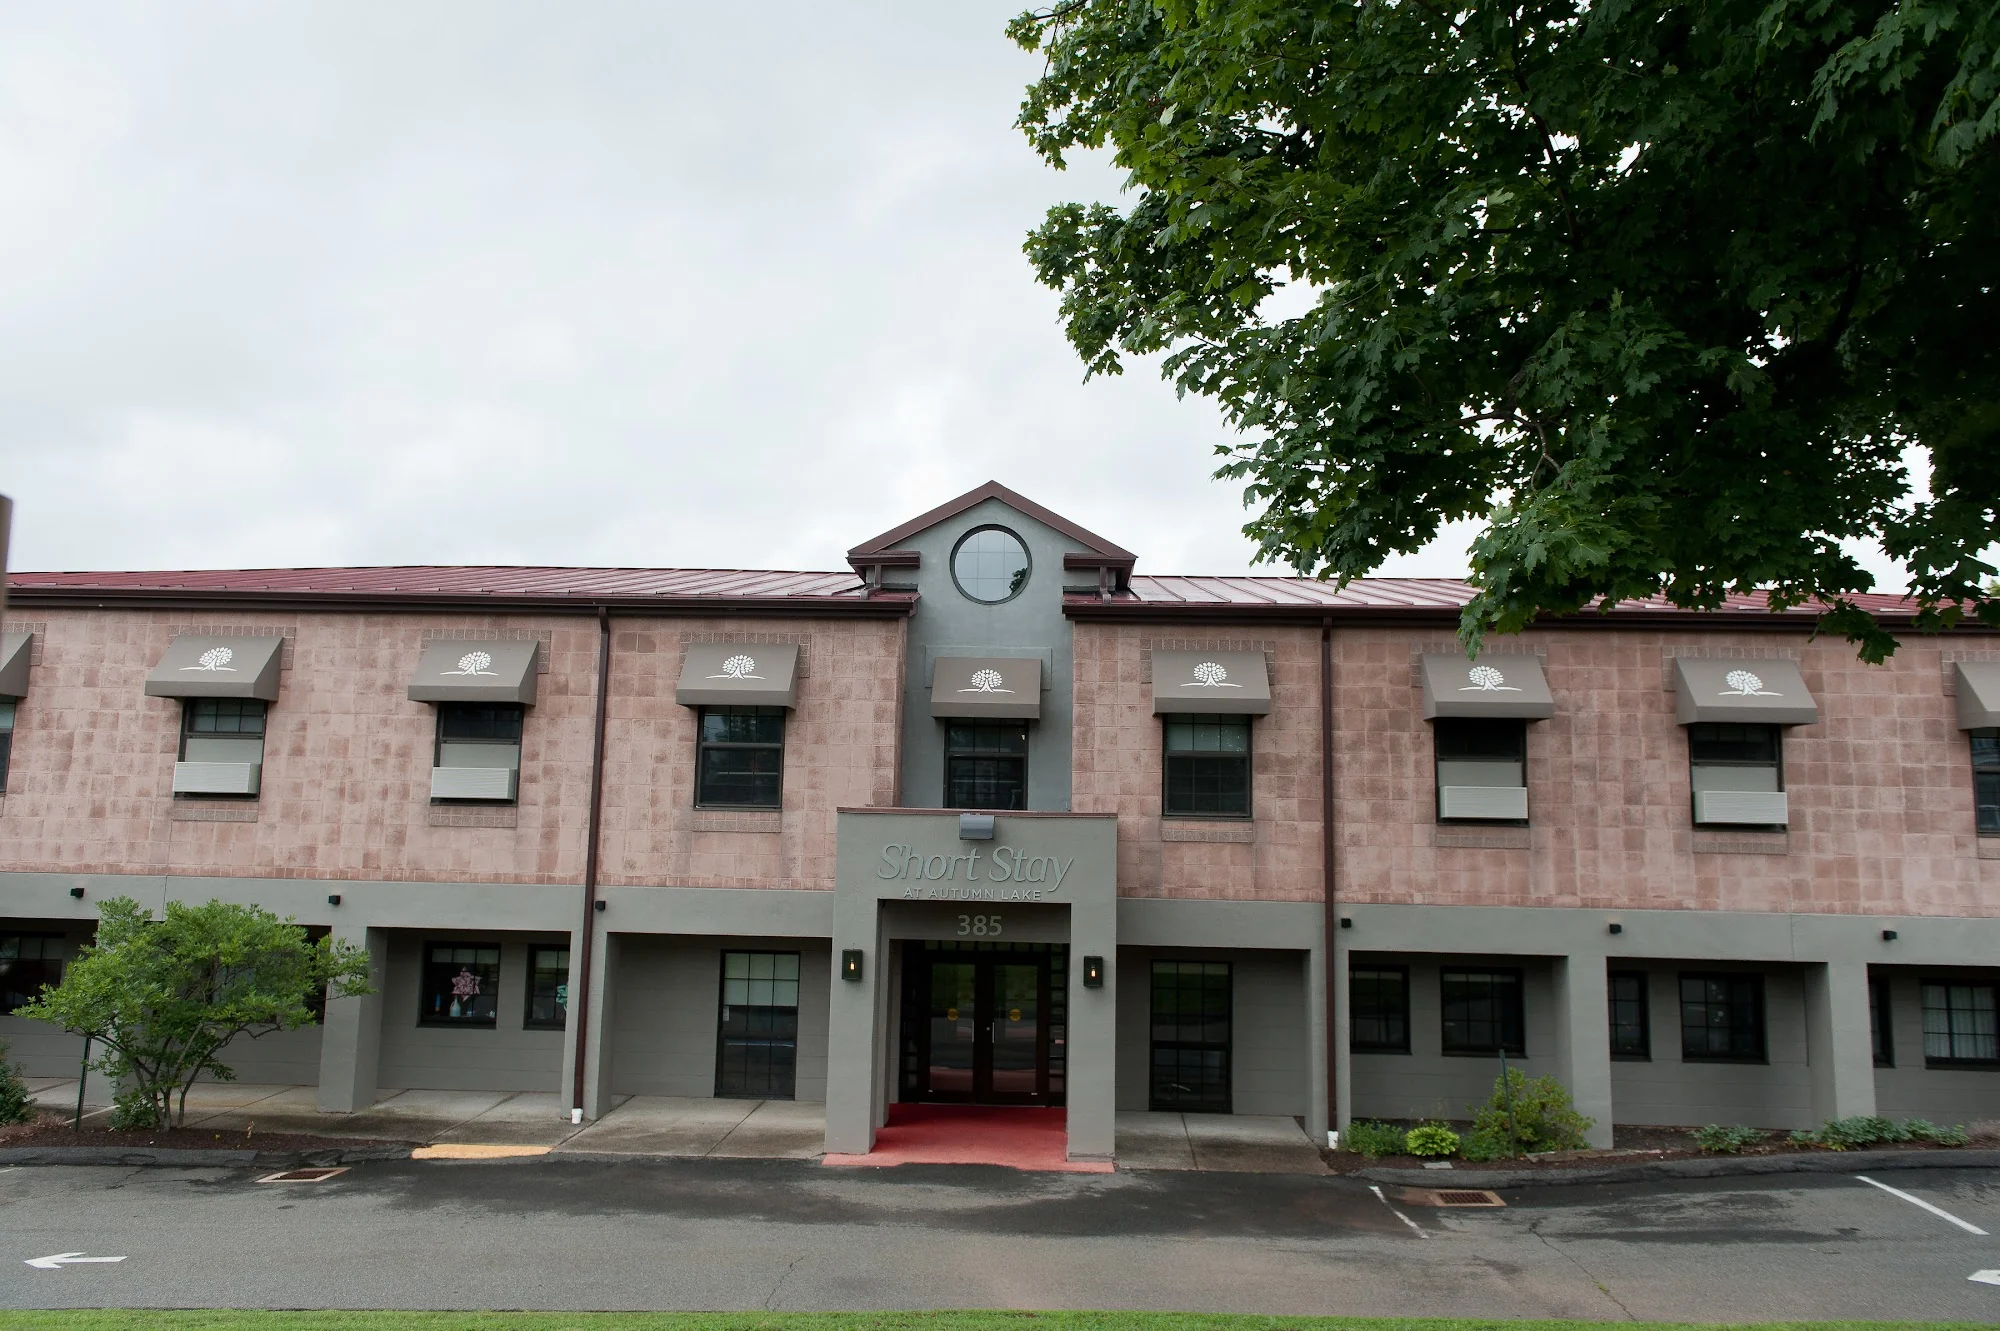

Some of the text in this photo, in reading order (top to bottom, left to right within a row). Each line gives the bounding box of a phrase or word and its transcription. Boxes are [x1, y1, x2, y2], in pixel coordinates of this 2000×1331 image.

[877, 844, 1074, 893] Short Stay
[903, 887, 1041, 901] AT AUTUMN LAKE
[957, 914, 1002, 936] 385
